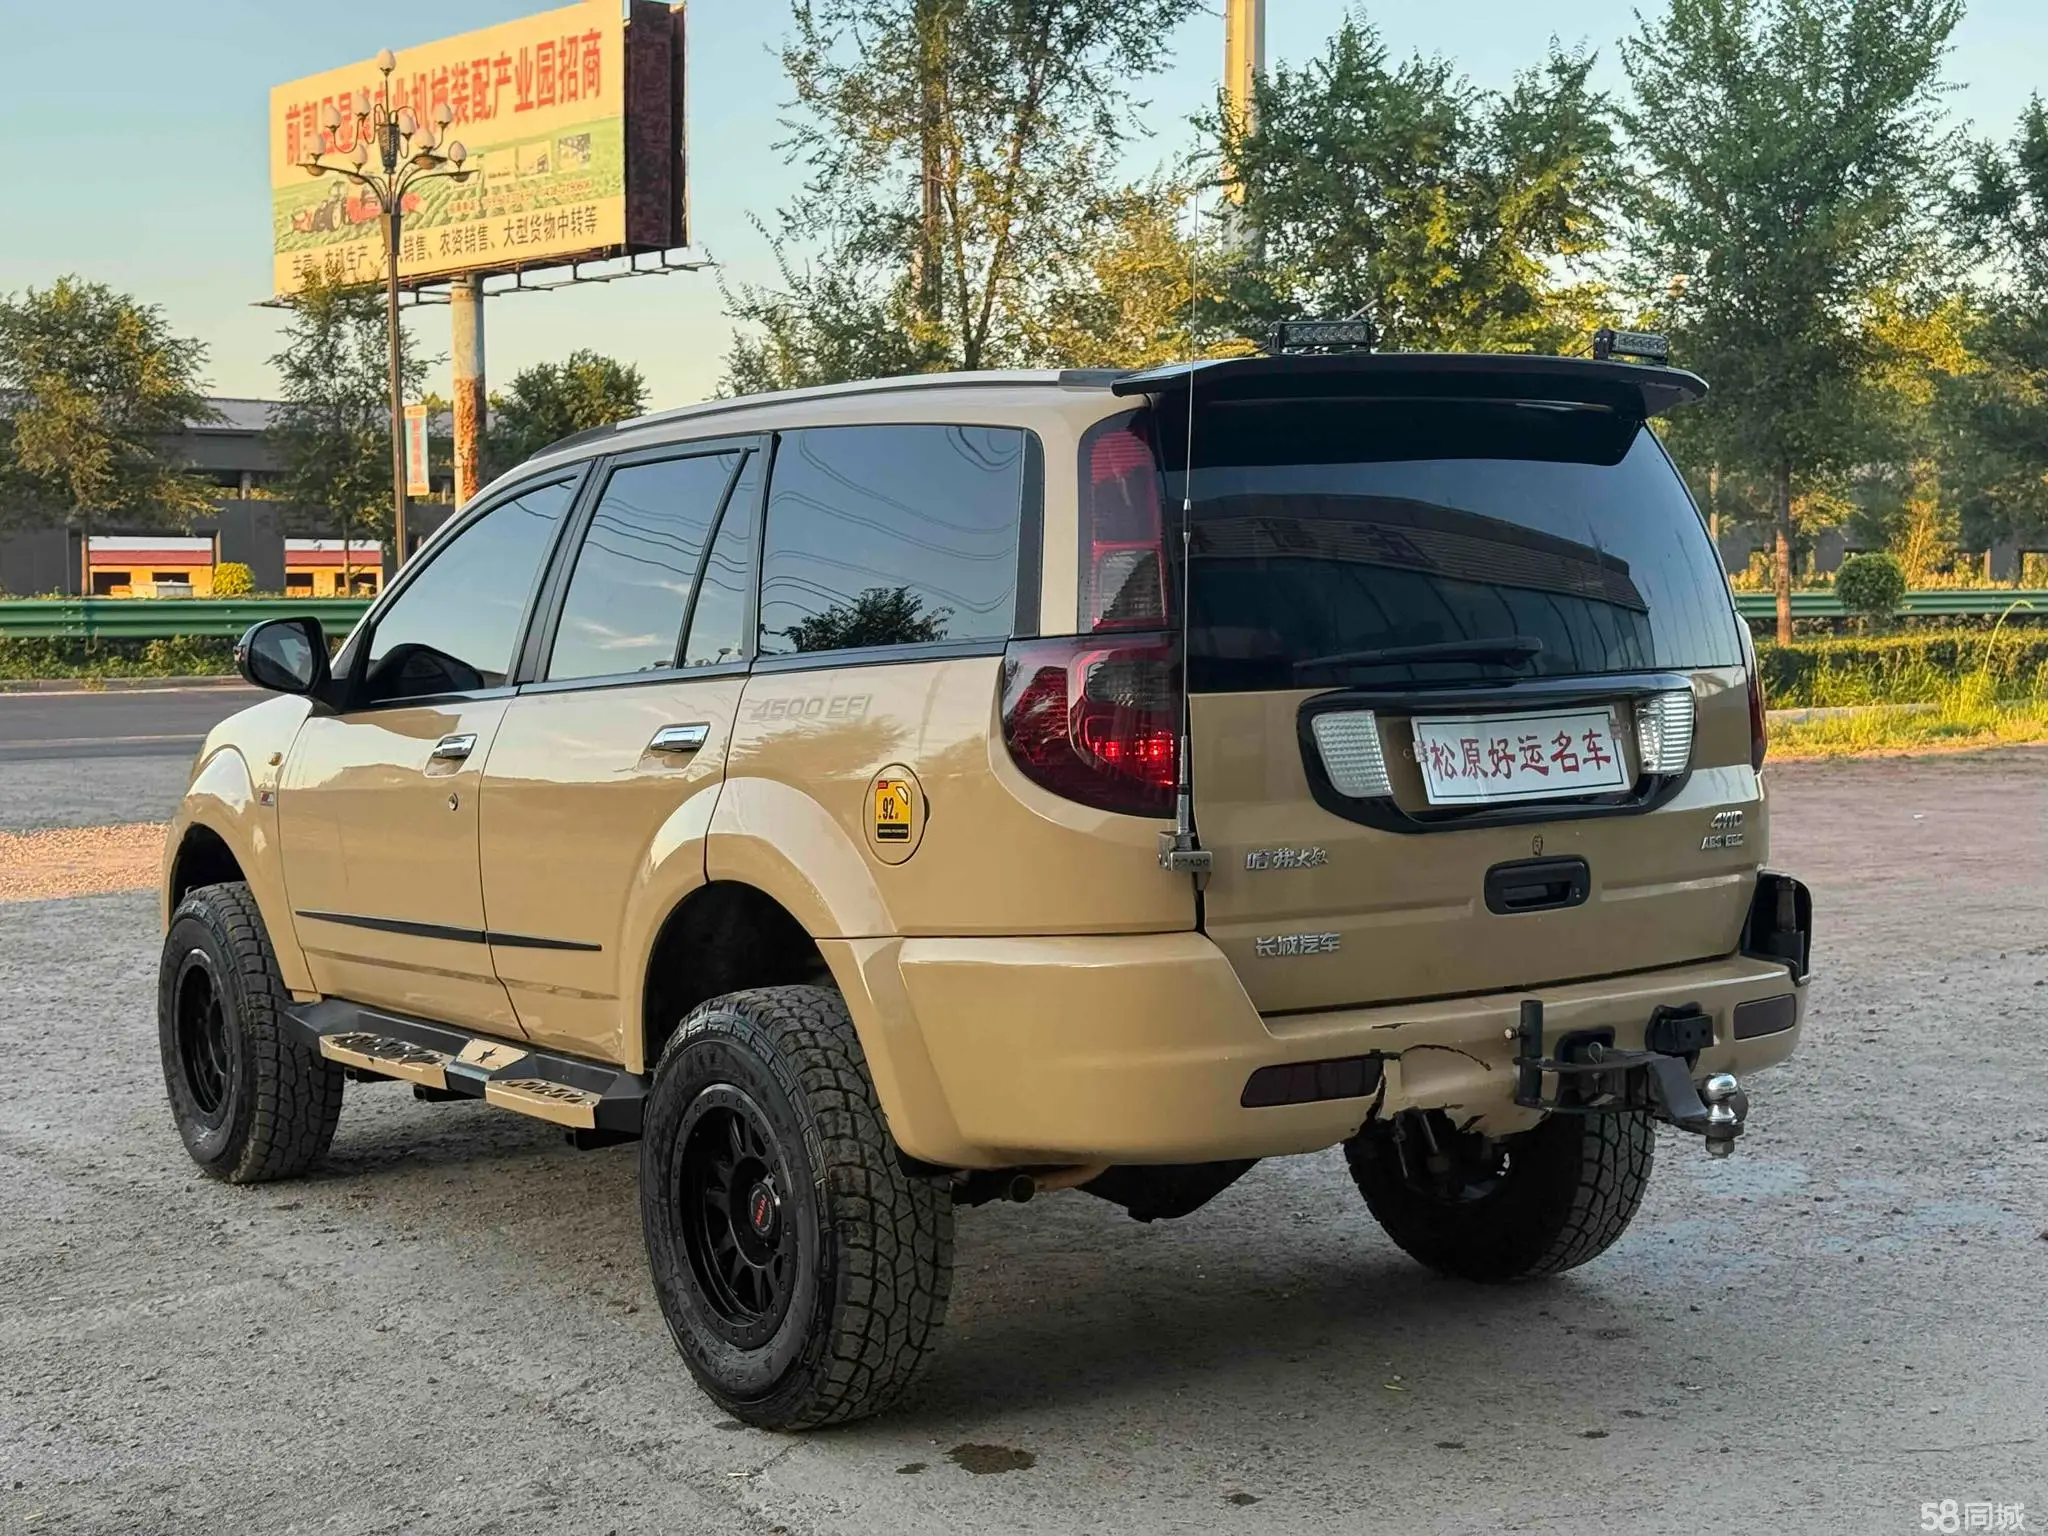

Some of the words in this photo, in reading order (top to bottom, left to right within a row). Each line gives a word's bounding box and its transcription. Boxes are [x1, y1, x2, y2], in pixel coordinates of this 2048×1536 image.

[1429, 728, 1612, 781] 松原好运名车
[1255, 932, 1341, 957] 长城汽车
